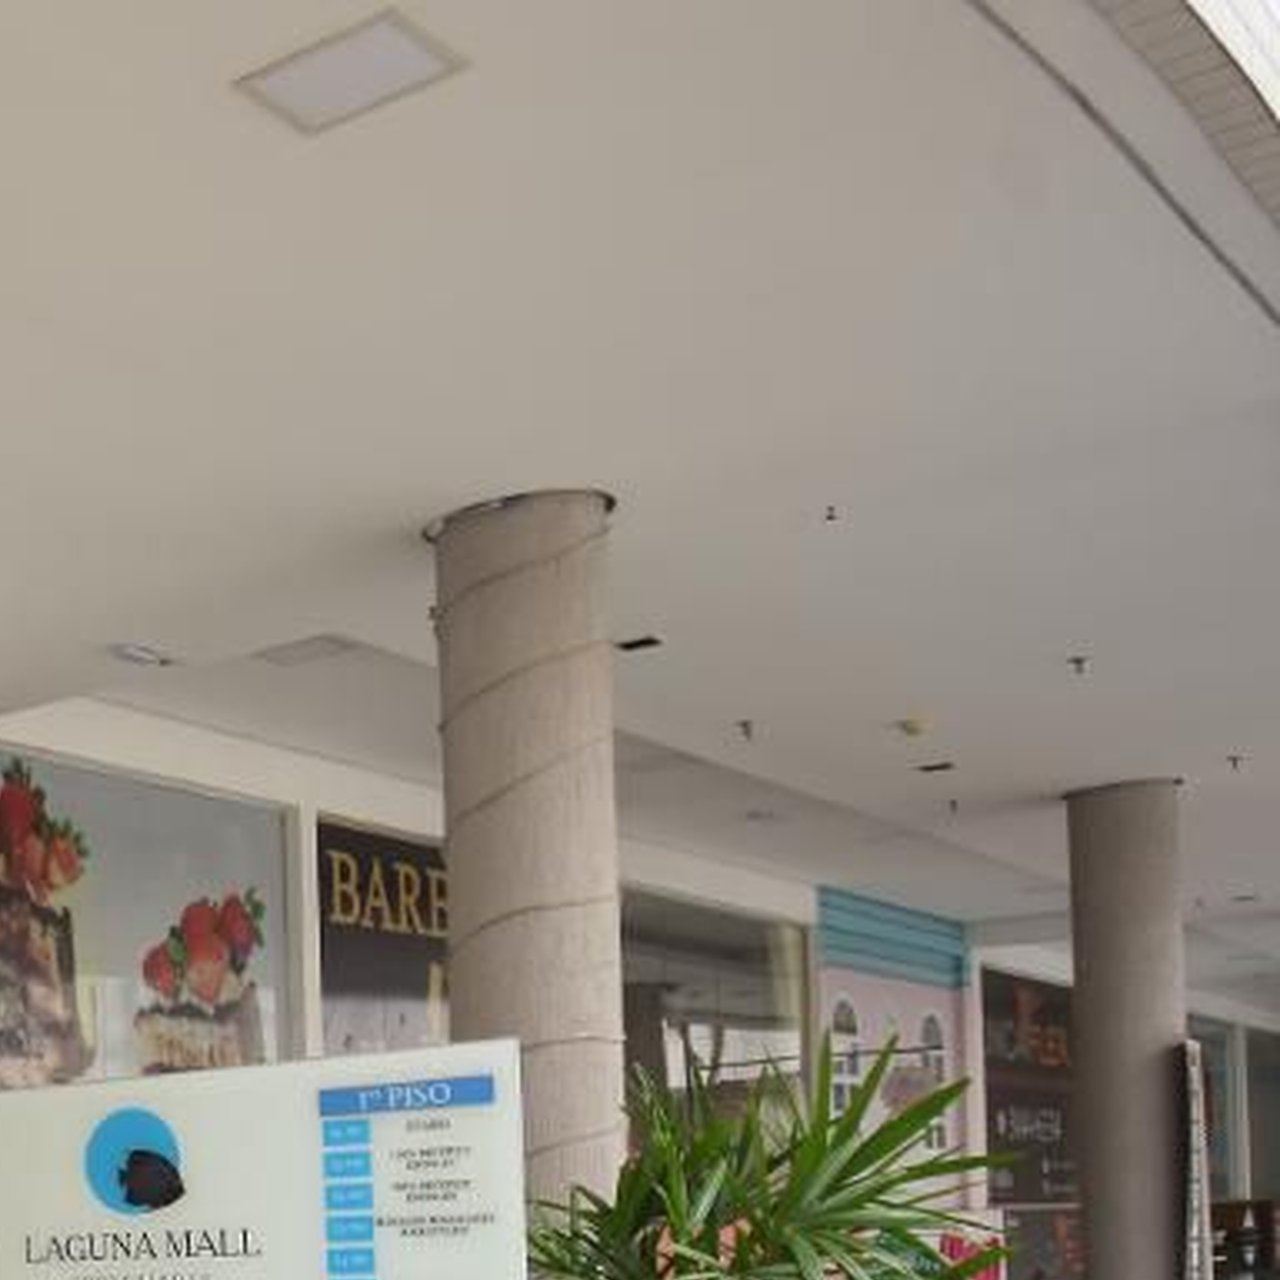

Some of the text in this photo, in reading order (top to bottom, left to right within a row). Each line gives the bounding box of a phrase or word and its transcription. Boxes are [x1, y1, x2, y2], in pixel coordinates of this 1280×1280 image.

[389, 1082, 452, 1107] PISO
[25, 1228, 263, 1265] LAGUNA MALL
